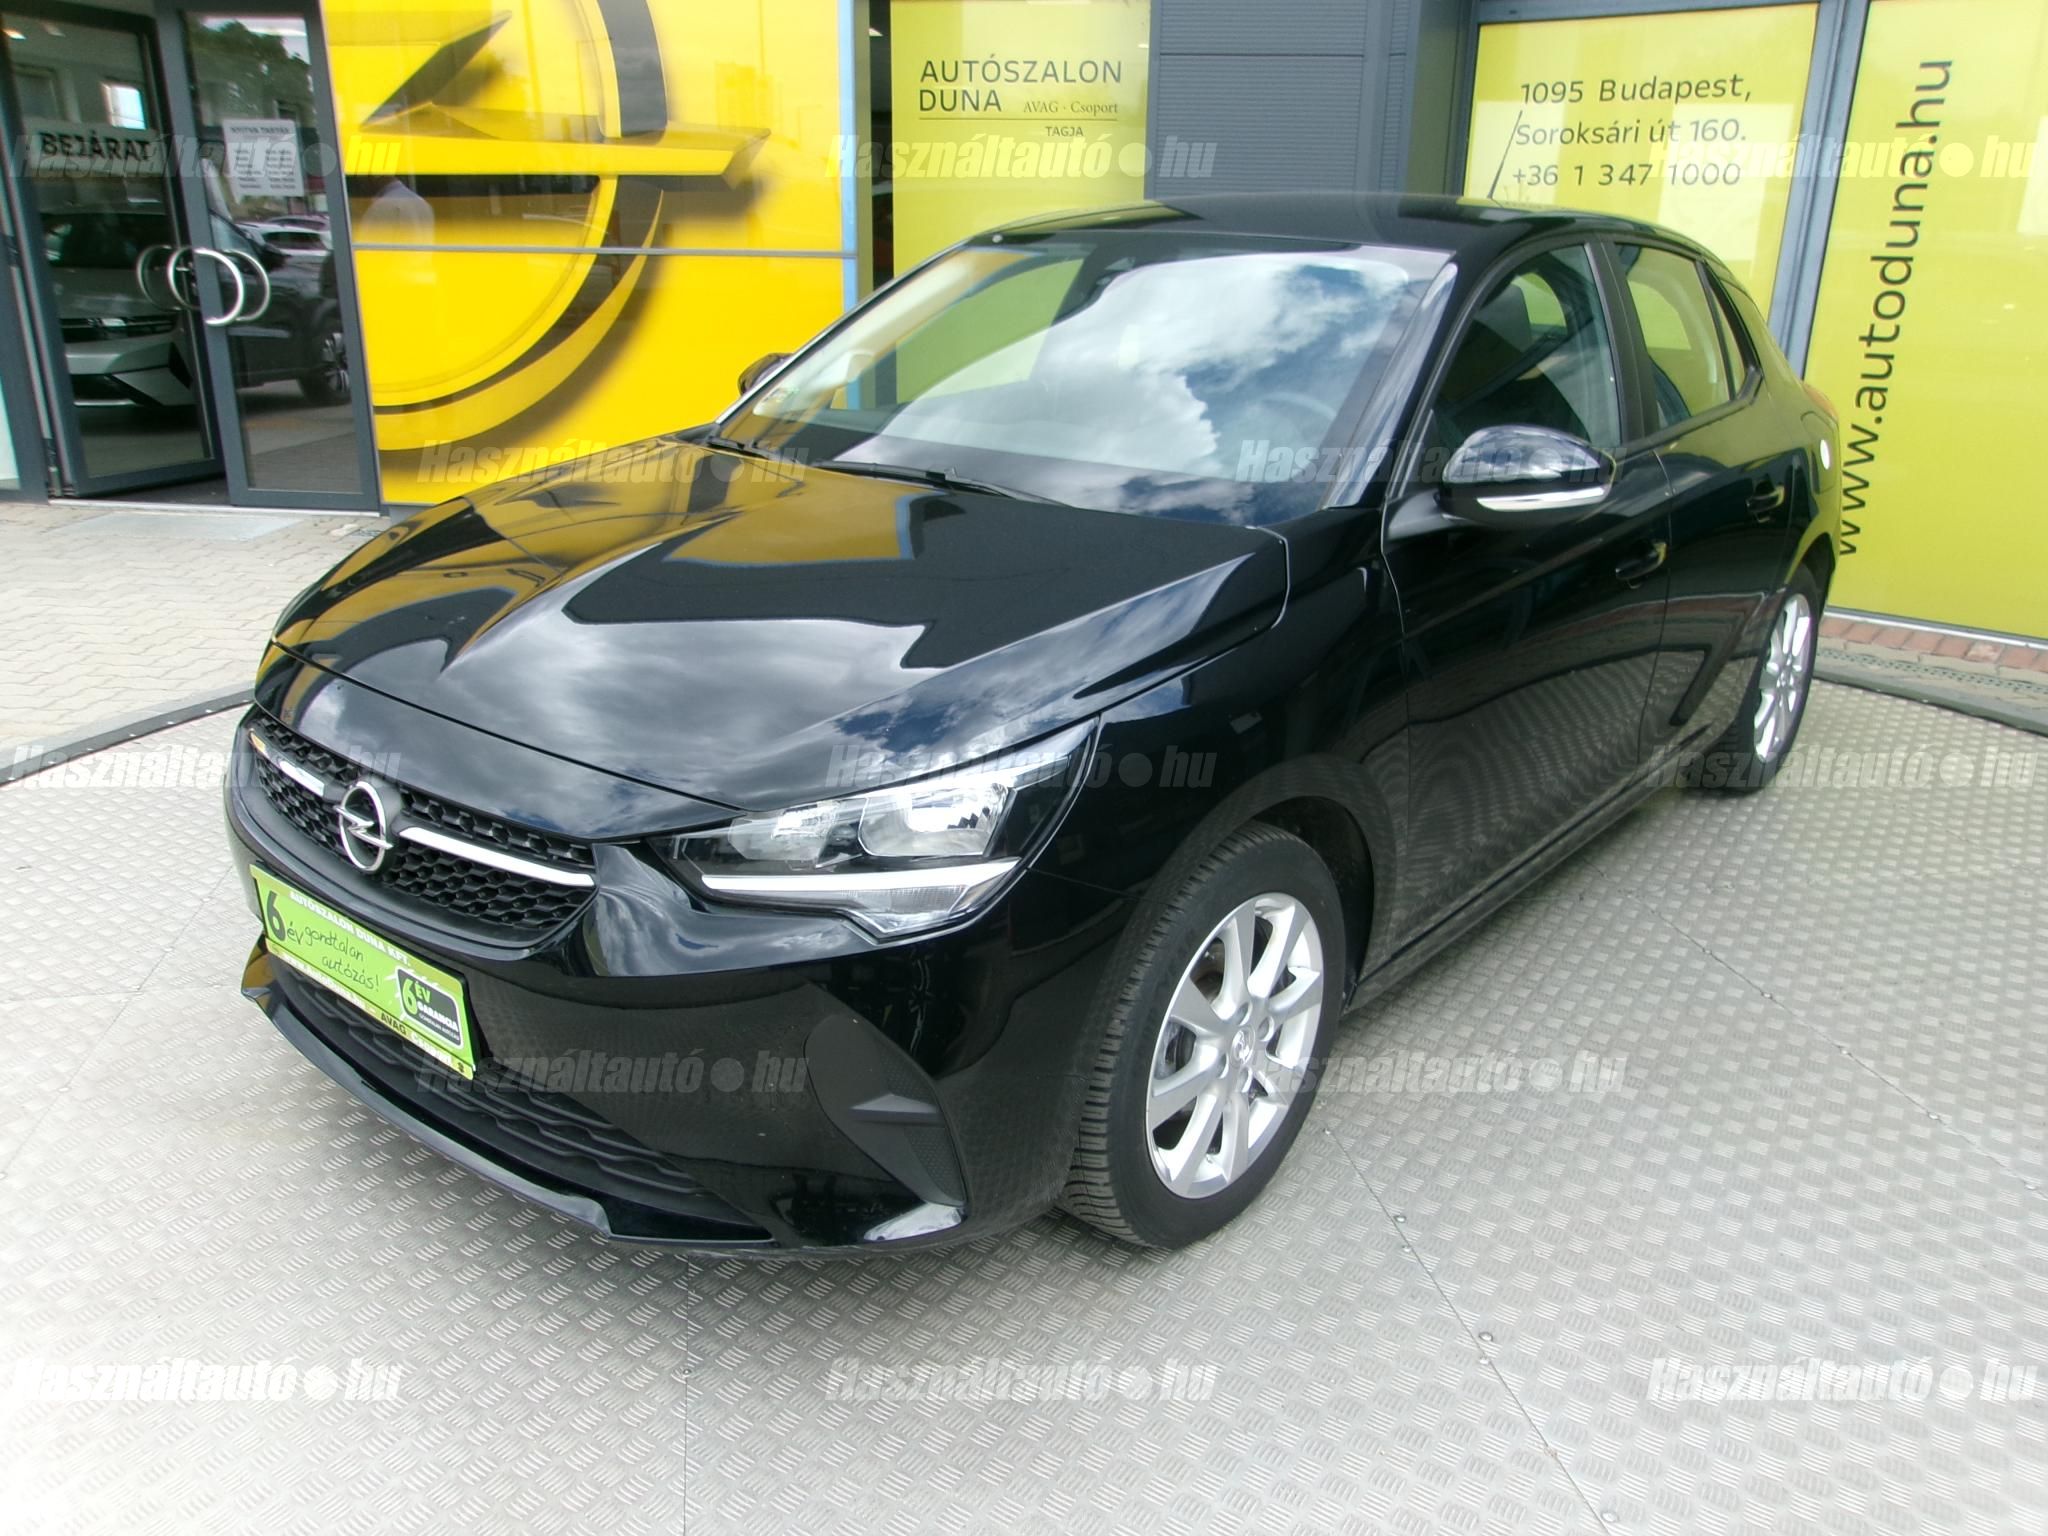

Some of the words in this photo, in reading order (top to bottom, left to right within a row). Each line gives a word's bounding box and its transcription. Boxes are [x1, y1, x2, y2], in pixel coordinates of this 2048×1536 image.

[919, 53, 1122, 84] AUTÓSZALON
[919, 88, 1002, 112] DUNA
[1023, 101, 1059, 113] AVAG
[1070, 100, 1118, 116] Csoport
[1520, 80, 1584, 104] 1095
[1598, 73, 1752, 104] Budapest,
[40, 129, 151, 161] BEJÁRAT
[1045, 126, 1084, 137] TAGJA
[1515, 119, 1640, 146] Soroksári
[1649, 119, 1681, 144] út
[1689, 118, 1747, 143] 160.
[1511, 164, 1560, 187] +36
[1574, 164, 1585, 187] 1
[1668, 163, 1742, 186] 1000
[1839, 59, 1953, 557] www.autoduna.hu
[266, 890, 286, 942] 6
[286, 921, 305, 945] év
[380, 1012, 407, 1036] AVAG
